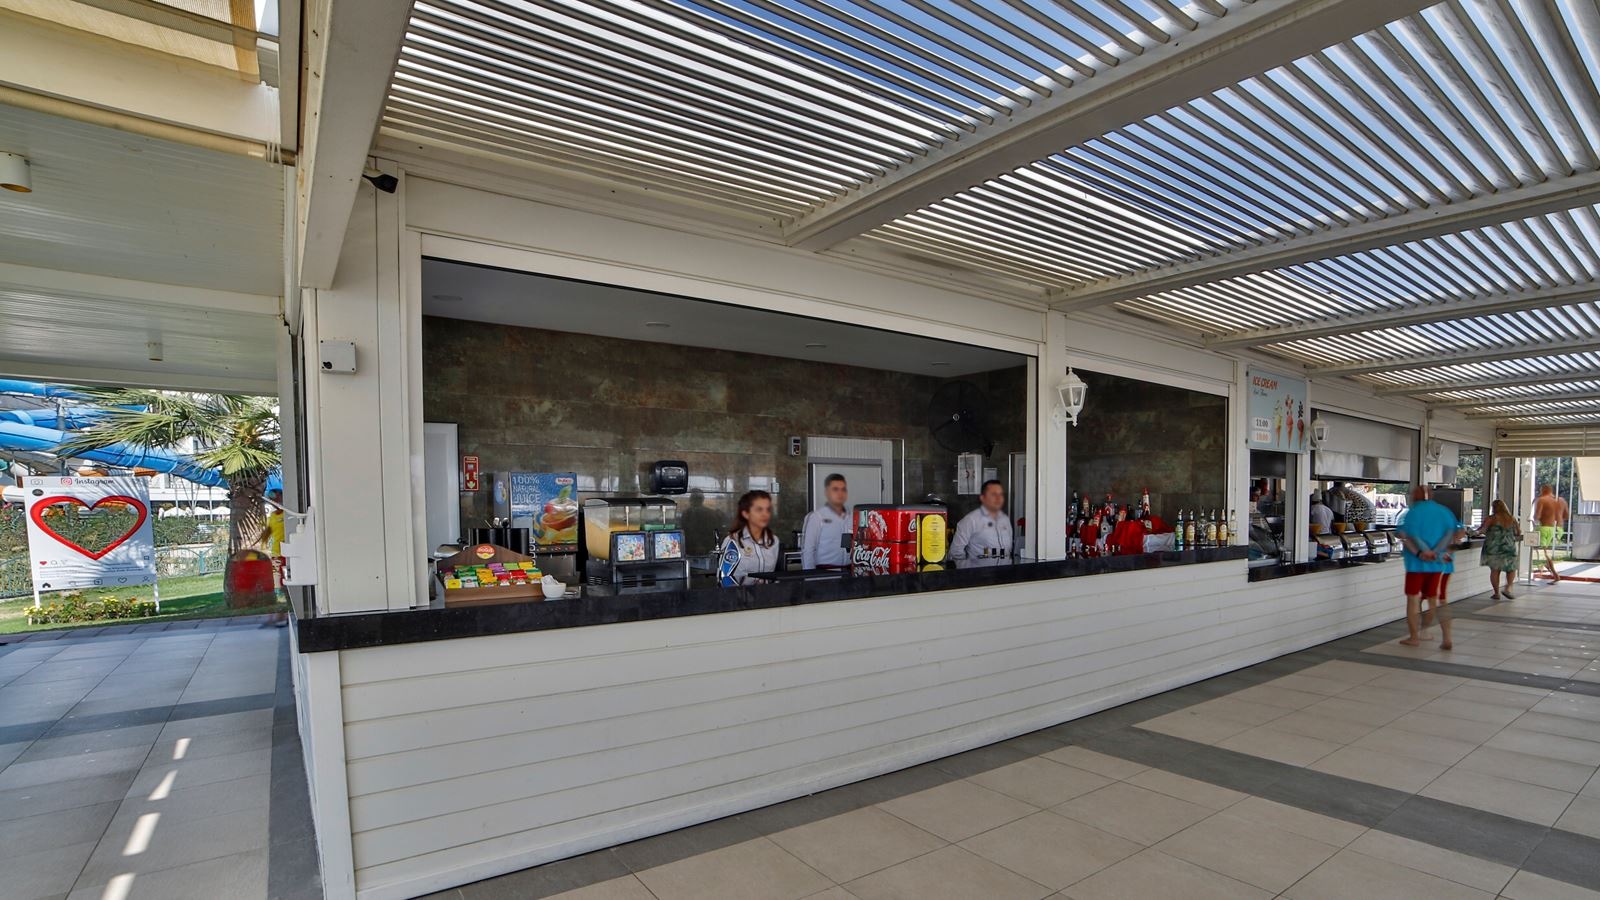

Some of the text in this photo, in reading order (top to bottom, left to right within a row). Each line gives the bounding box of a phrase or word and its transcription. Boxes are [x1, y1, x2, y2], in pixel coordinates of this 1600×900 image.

[1261, 378, 1278, 389] CREAM
[74, 478, 114, 487] Instagram
[511, 475, 540, 485] 100%
[512, 493, 541, 505] JUICE
